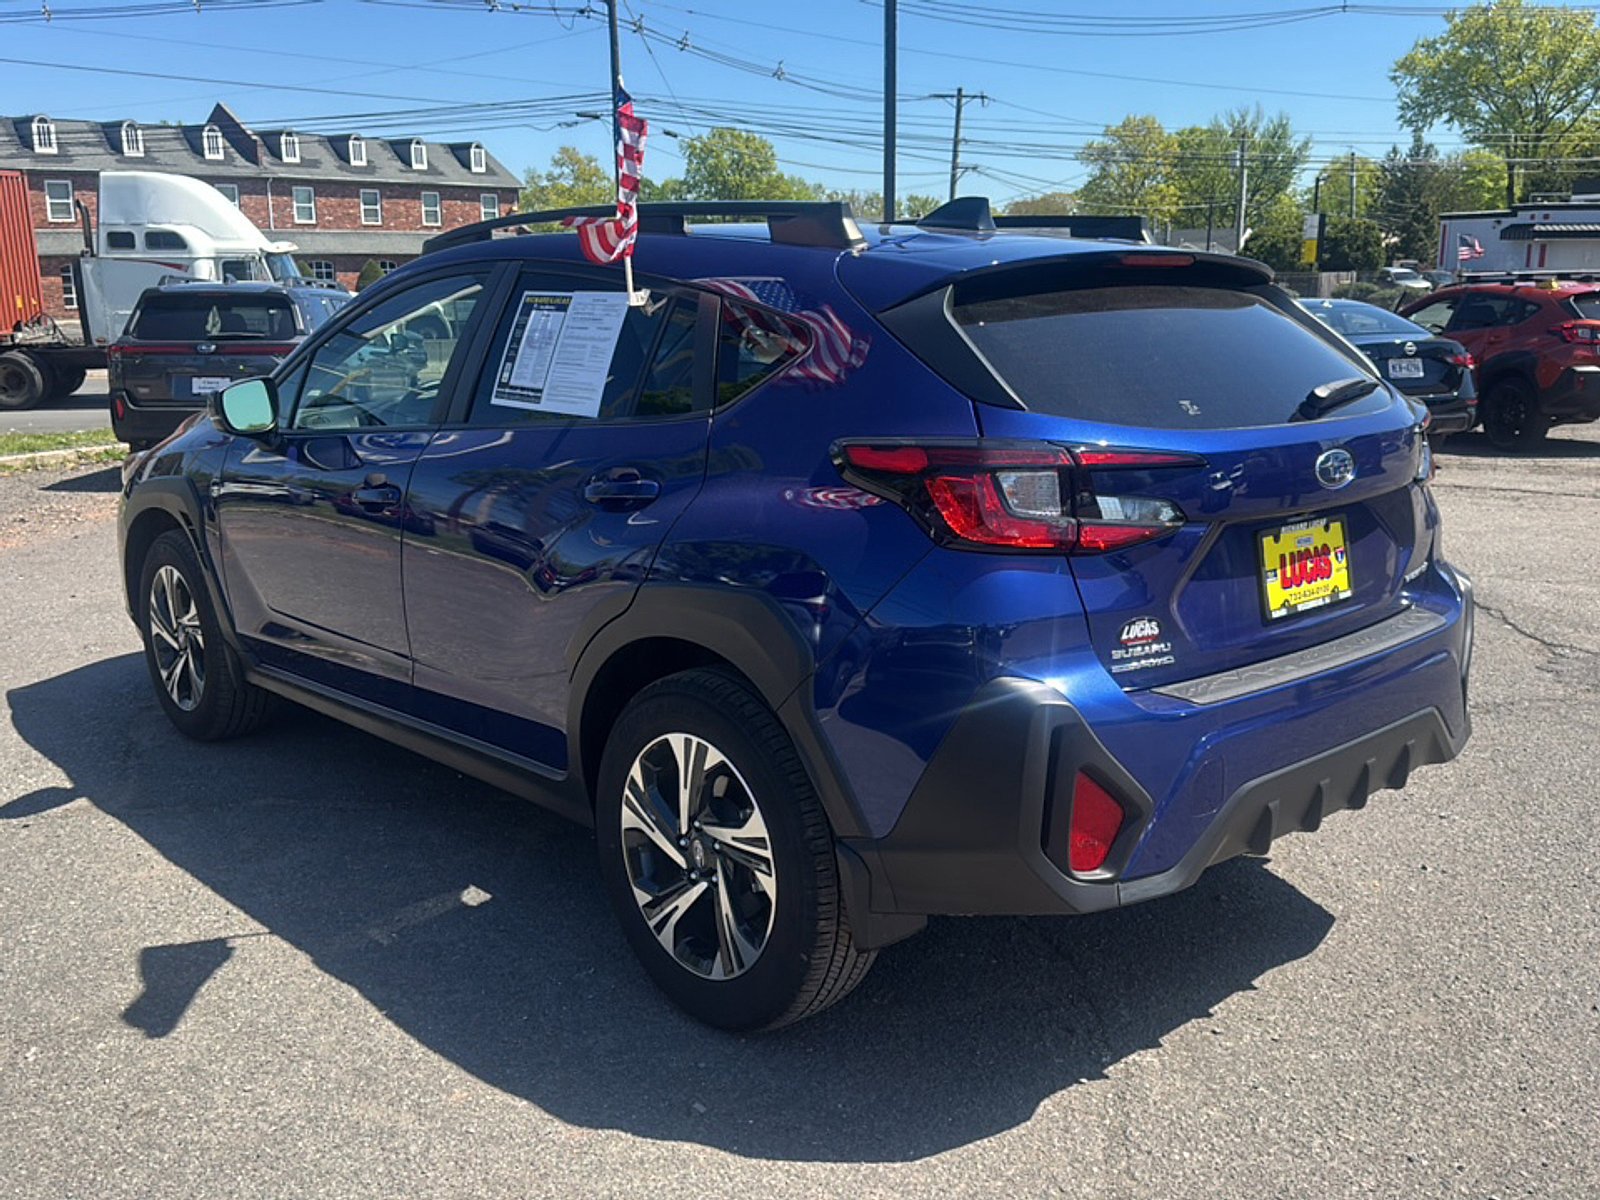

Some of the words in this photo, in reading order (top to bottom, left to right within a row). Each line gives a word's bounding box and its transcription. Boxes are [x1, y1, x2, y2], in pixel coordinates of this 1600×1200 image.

[1279, 544, 1332, 590] LUCAS
[1121, 621, 1160, 640] LUCAS
[1111, 642, 1171, 659] SUBARU
